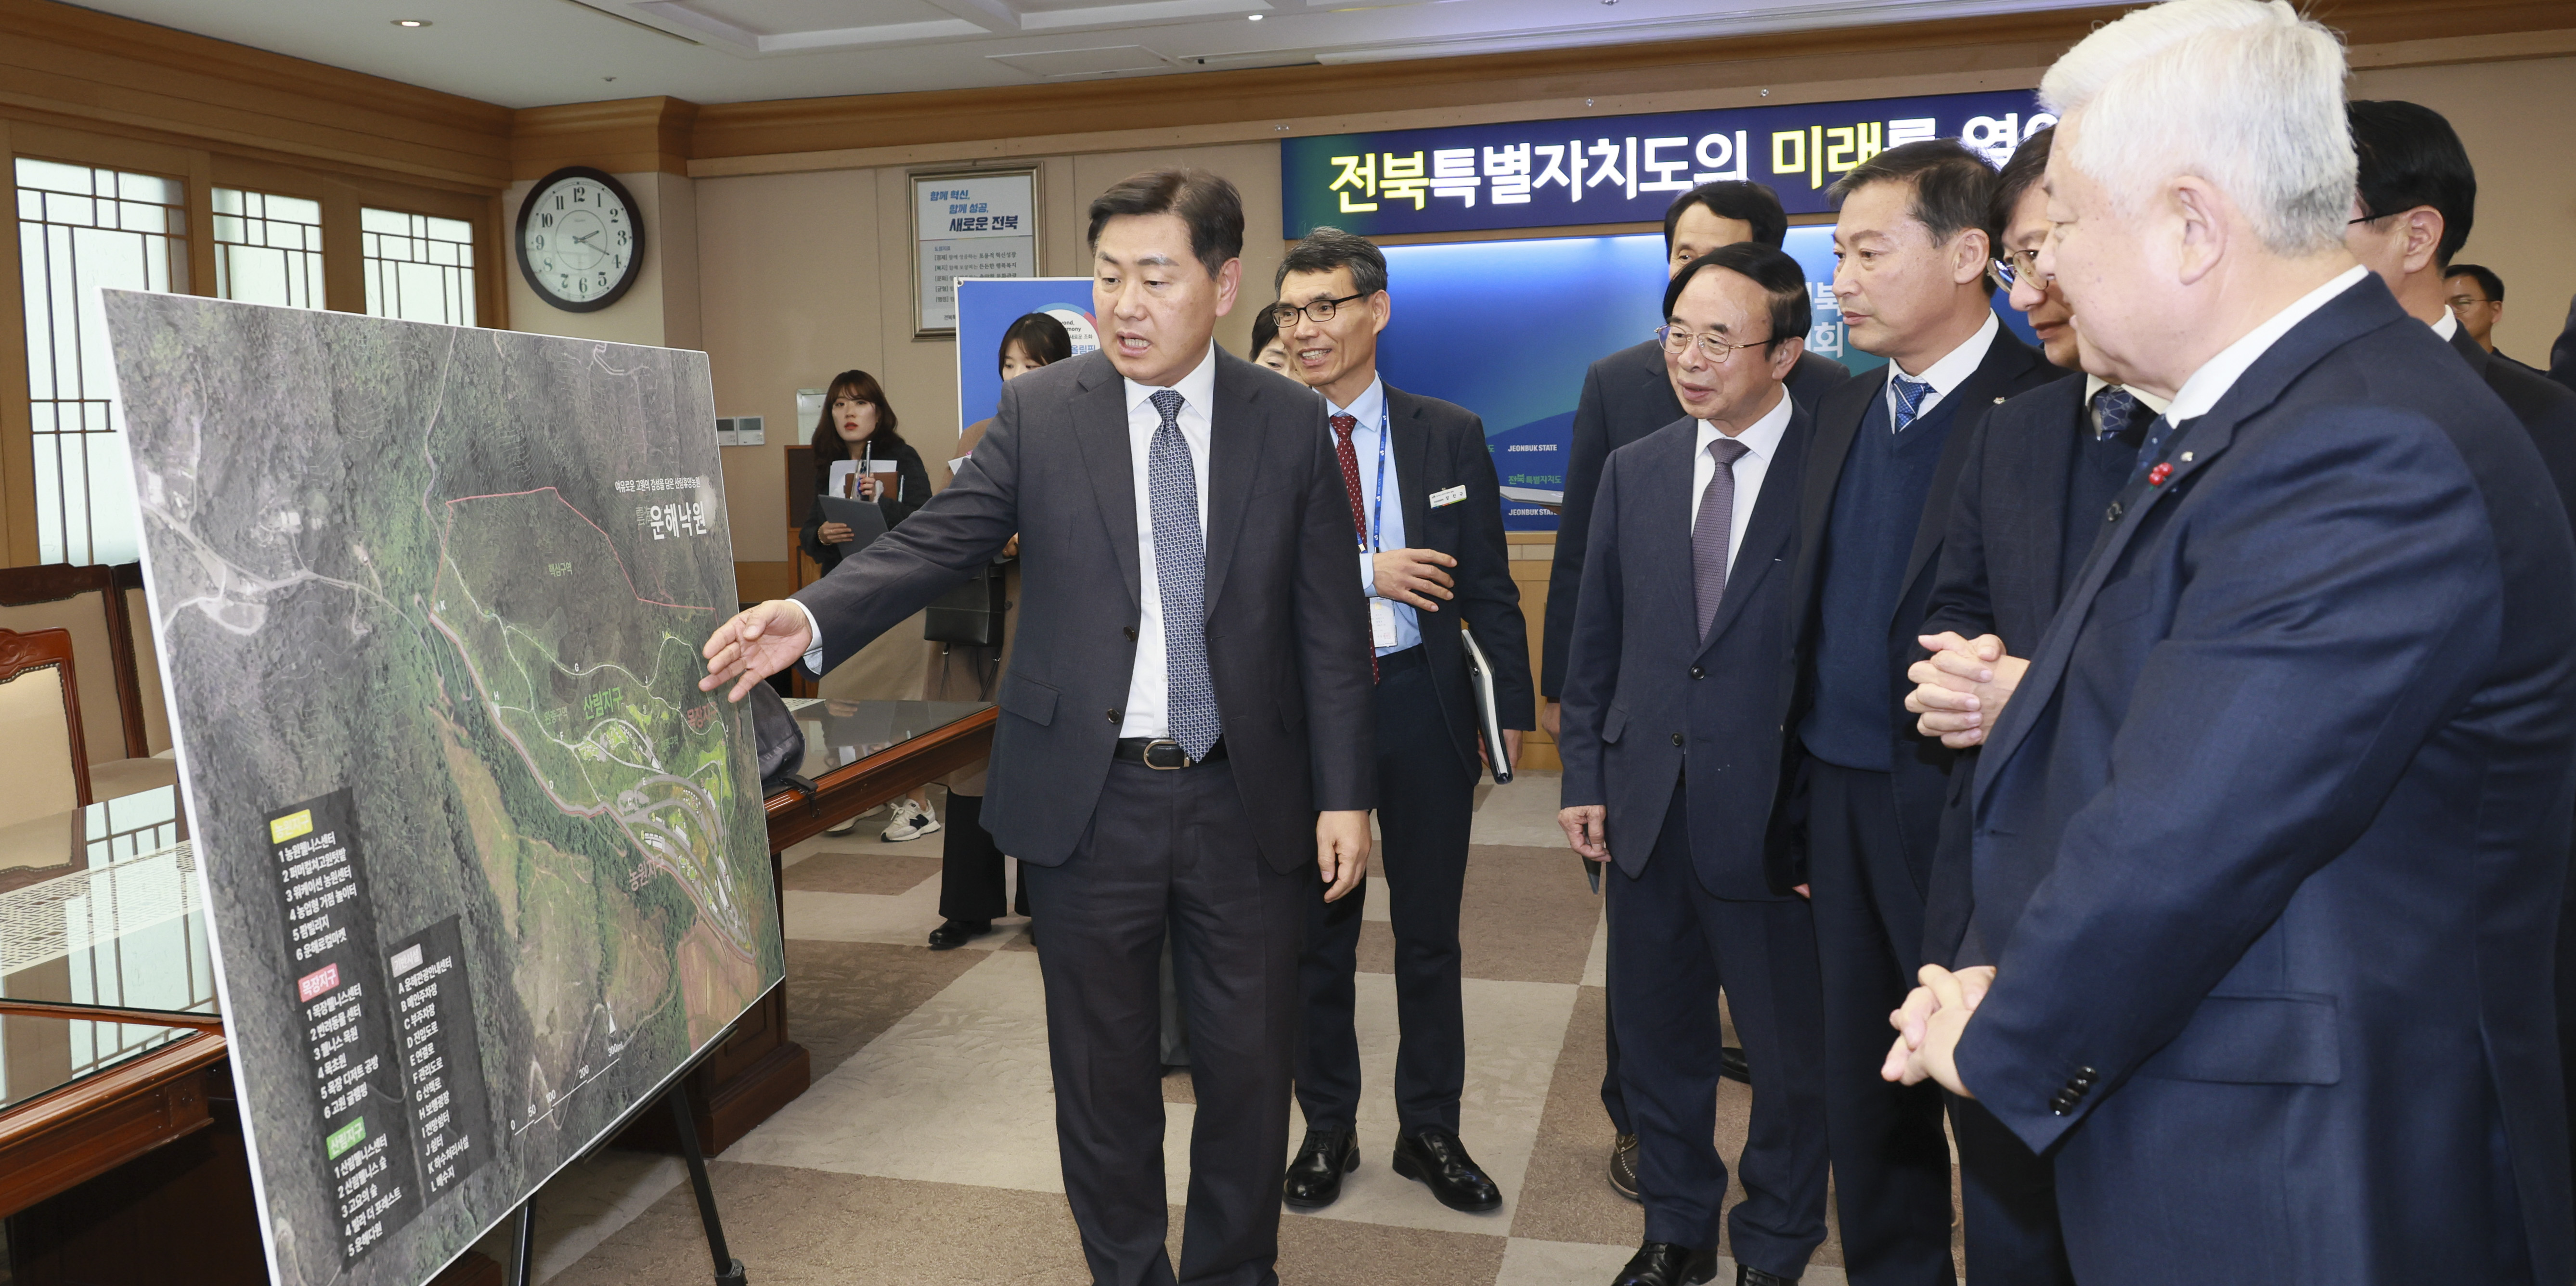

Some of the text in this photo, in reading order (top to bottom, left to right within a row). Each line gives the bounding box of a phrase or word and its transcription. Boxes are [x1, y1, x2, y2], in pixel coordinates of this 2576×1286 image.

[1329, 130, 1748, 213] 전북특별자치도의
[556, 195, 564, 210] 11
[573, 187, 585, 203] 12
[597, 193, 601, 207] 1
[930, 190, 970, 201] 함께 혁신,
[541, 213, 553, 228] 10
[610, 208, 619, 223] 2
[949, 203, 989, 214] 함께 성공,
[950, 216, 1018, 231] 새로운 전북
[536, 235, 544, 250] 9
[618, 230, 627, 246] 3
[544, 257, 552, 272] 8
[612, 254, 621, 269] 4
[561, 273, 569, 288] 7
[579, 277, 587, 293] 6
[598, 271, 607, 286] 5
[636, 478, 650, 491] 고원의
[650, 478, 665, 491] 감성을
[665, 477, 674, 490] 담은
[675, 476, 700, 489] 산림휴양농원
[650, 501, 707, 540] 운해낙원
[548, 561, 573, 578] 핵심구역
[440, 600, 446, 610] K
[574, 663, 579, 672] G
[494, 691, 499, 701] H
[583, 687, 623, 720] 산림지구
[549, 780, 554, 789] D
[274, 814, 310, 839] 농원지구
[278, 831, 336, 862] 1 농원웰니스센터
[282, 870, 289, 883] 2
[285, 865, 352, 902] 3 워케이션 농원센터
[289, 882, 357, 921] 4 농업형 거점 놀이터
[293, 914, 330, 941] 5 팜빌리지
[296, 948, 303, 961] 6
[302, 967, 337, 996] 목장지구
[398, 955, 453, 994] A 운해관광안내센터
[307, 983, 362, 1021] 1 목장웰니스센터
[401, 982, 438, 1012] B 메인주차장
[310, 1003, 362, 1041] 2 반려동물 센터
[404, 1003, 435, 1030] C 부주차장
[313, 1025, 359, 1060] 3 웰니스 목원
[407, 1021, 439, 1049] D 진입도로
[317, 1053, 347, 1079] 4 목초원
[410, 1042, 435, 1067] E 연결로
[321, 1054, 379, 1099] 5 목장 디저트 공방
[413, 1056, 444, 1084] F 관리도로
[579, 1064, 590, 1079] 200
[324, 1081, 367, 1119] 6 고원 글램핑
[416, 1077, 442, 1102] G 산책로
[545, 1089, 556, 1104] 100
[418, 1090, 450, 1120] H 보행광장
[528, 1104, 536, 1117] 50
[425, 1109, 451, 1136] 전망쉼터
[510, 1119, 516, 1130] 0
[330, 1121, 363, 1155] 산림지구
[425, 1133, 444, 1156] J 쉼터
[334, 1133, 388, 1179] 1 산림웰니스센터
[427, 1134, 470, 1174] K 하수처리시설
[338, 1156, 387, 1199] 2 산림웰니스 숲
[431, 1165, 455, 1193] L 배수지
[341, 1183, 378, 1218] 3 고요의 숲
[345, 1186, 402, 1236] 4 빌라 더 포레스트
[348, 1221, 383, 1257] 5 운해다원
